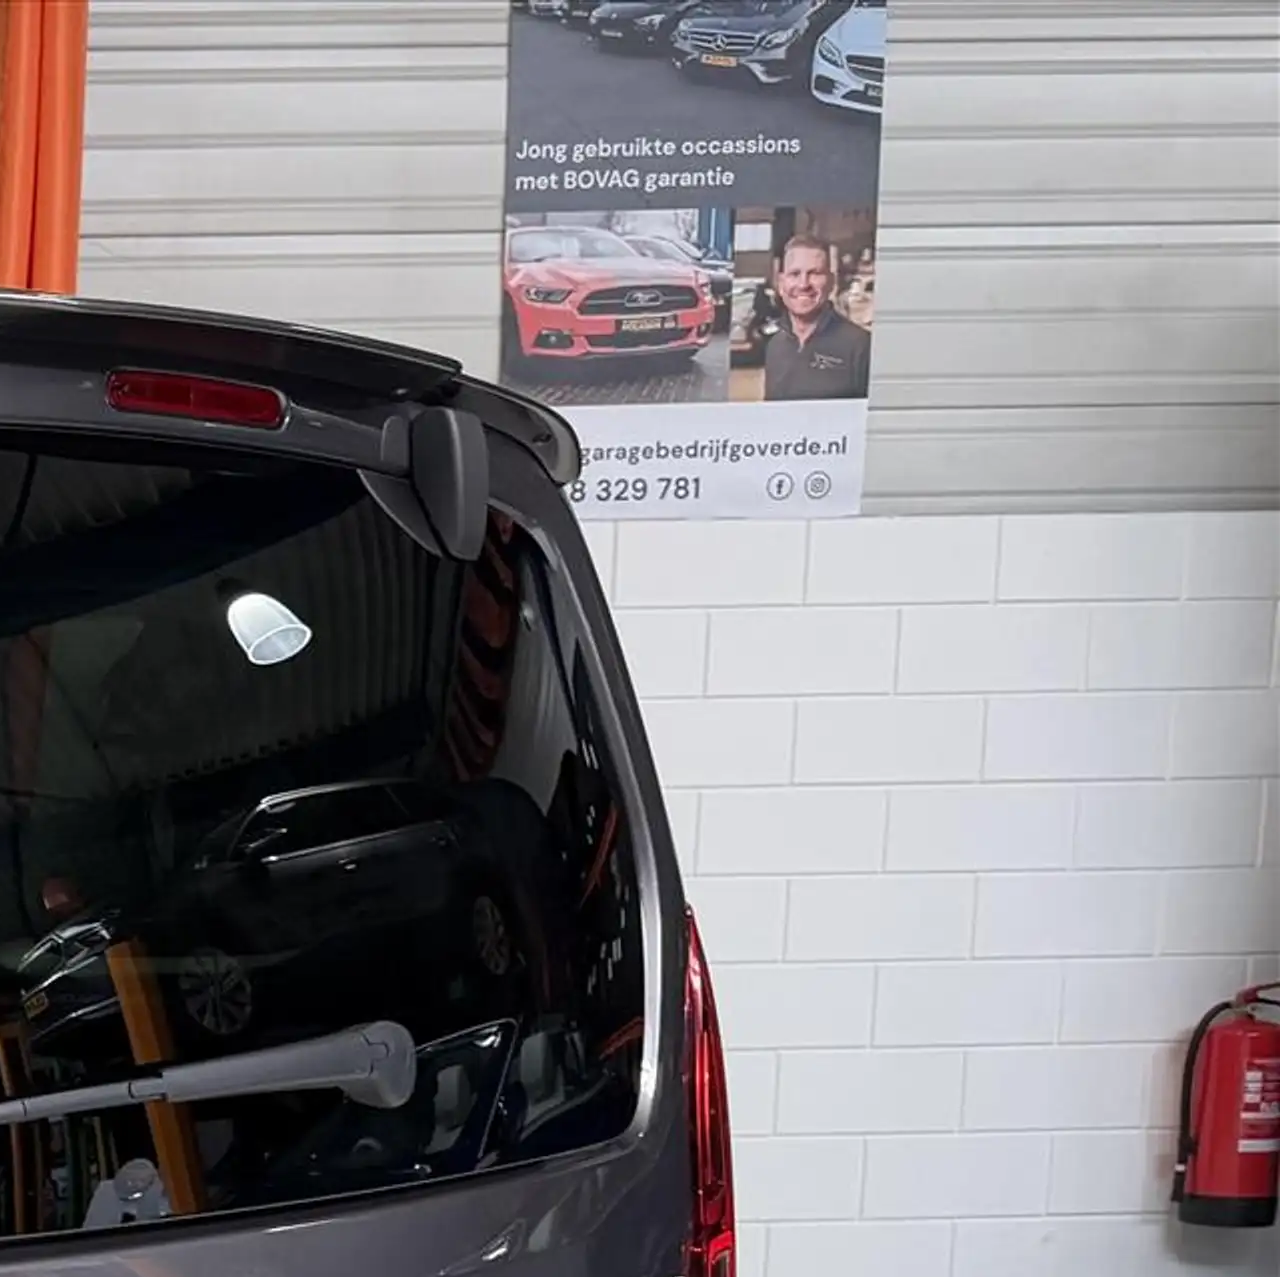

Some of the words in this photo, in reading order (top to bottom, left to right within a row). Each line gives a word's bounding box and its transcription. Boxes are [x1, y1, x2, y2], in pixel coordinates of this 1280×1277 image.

[515, 139, 567, 163] Jong
[572, 137, 676, 162] gebruikte
[681, 134, 801, 155] occassions
[515, 172, 558, 190] met
[563, 168, 640, 190] BOVAG
[645, 166, 734, 192] garantie
[580, 436, 848, 465] garagebedrijfgoverde.nl
[596, 478, 648, 501] 329
[656, 476, 701, 500] 781
